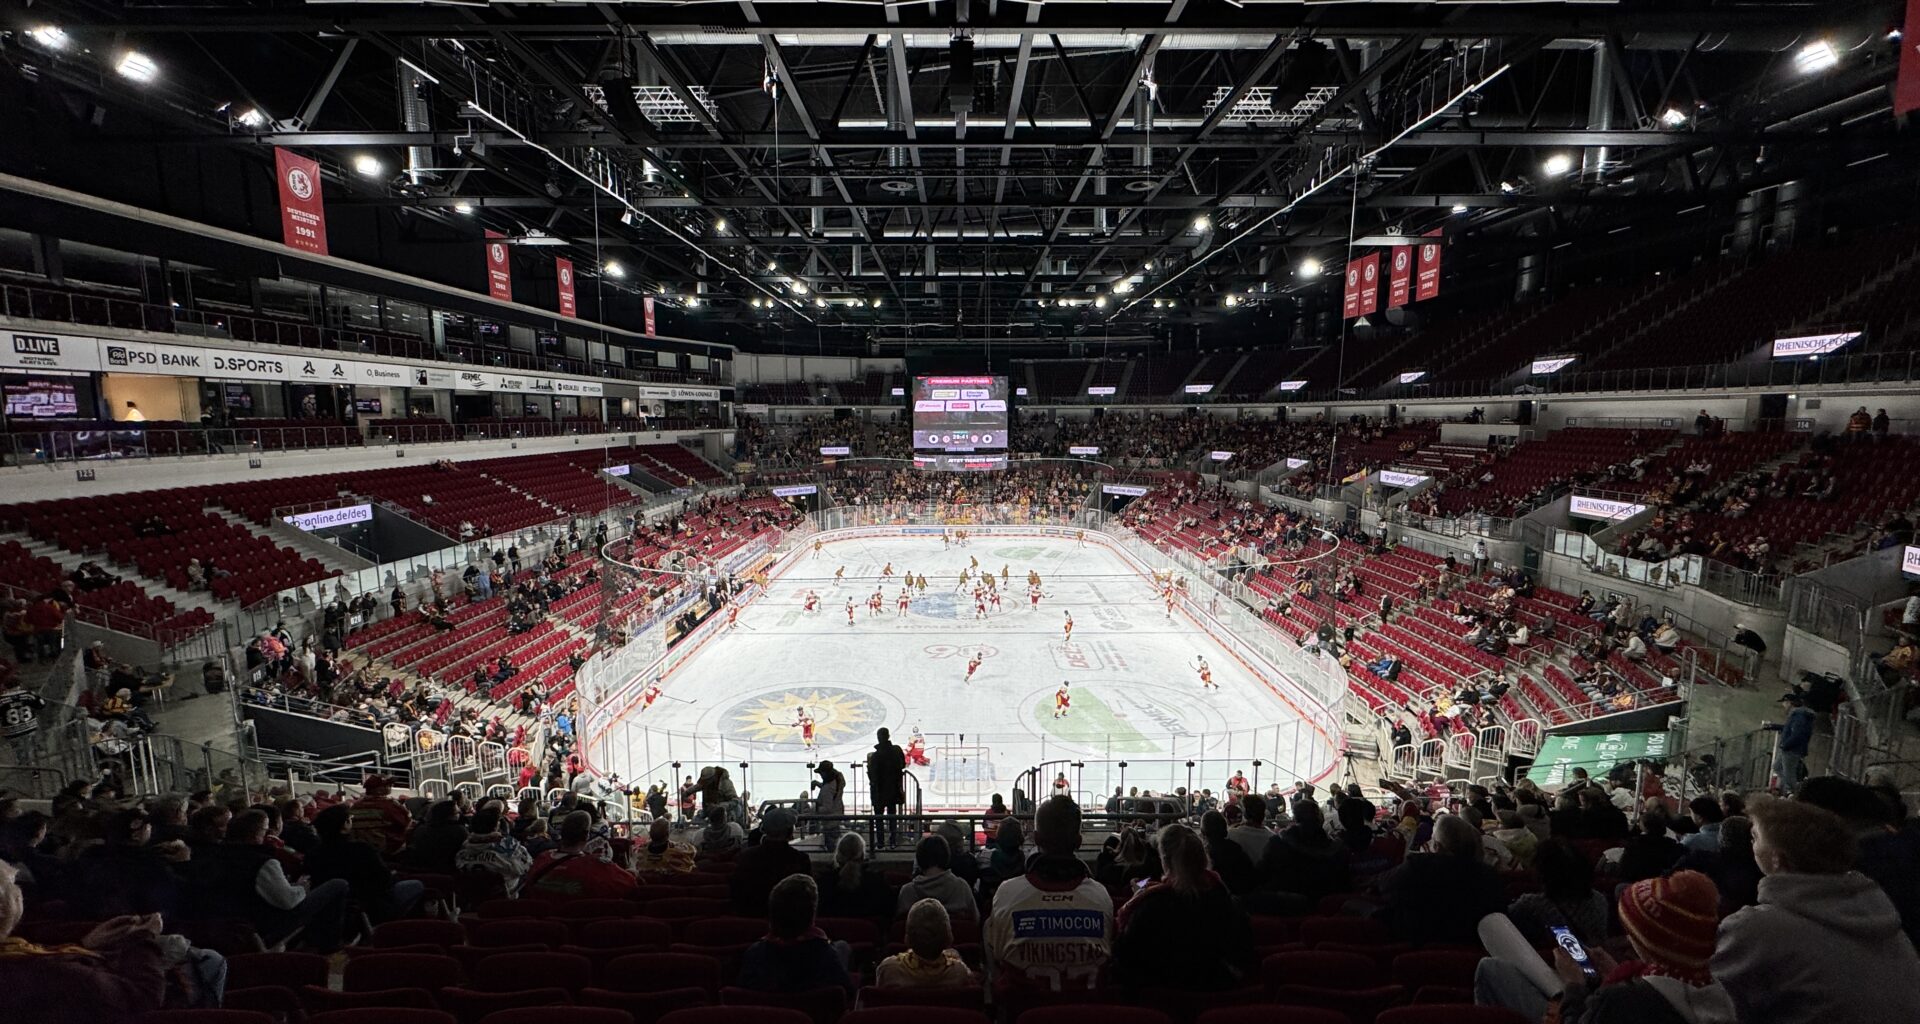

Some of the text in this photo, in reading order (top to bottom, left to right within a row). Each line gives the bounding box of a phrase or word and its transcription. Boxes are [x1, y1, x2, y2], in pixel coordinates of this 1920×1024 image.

[295, 226, 316, 239] 1991
[16, 337, 58, 353] D.LIVE
[1775, 337, 1828, 351] RHEINISCHE
[128, 351, 200, 367] PSD BANK
[214, 356, 283, 373] D.SPORTS
[374, 369, 400, 378] Business
[1577, 500, 1615, 513] RHEINISCHE
[1041, 894, 1074, 902] CCM
[1038, 916, 1101, 930] TIMOCOM
